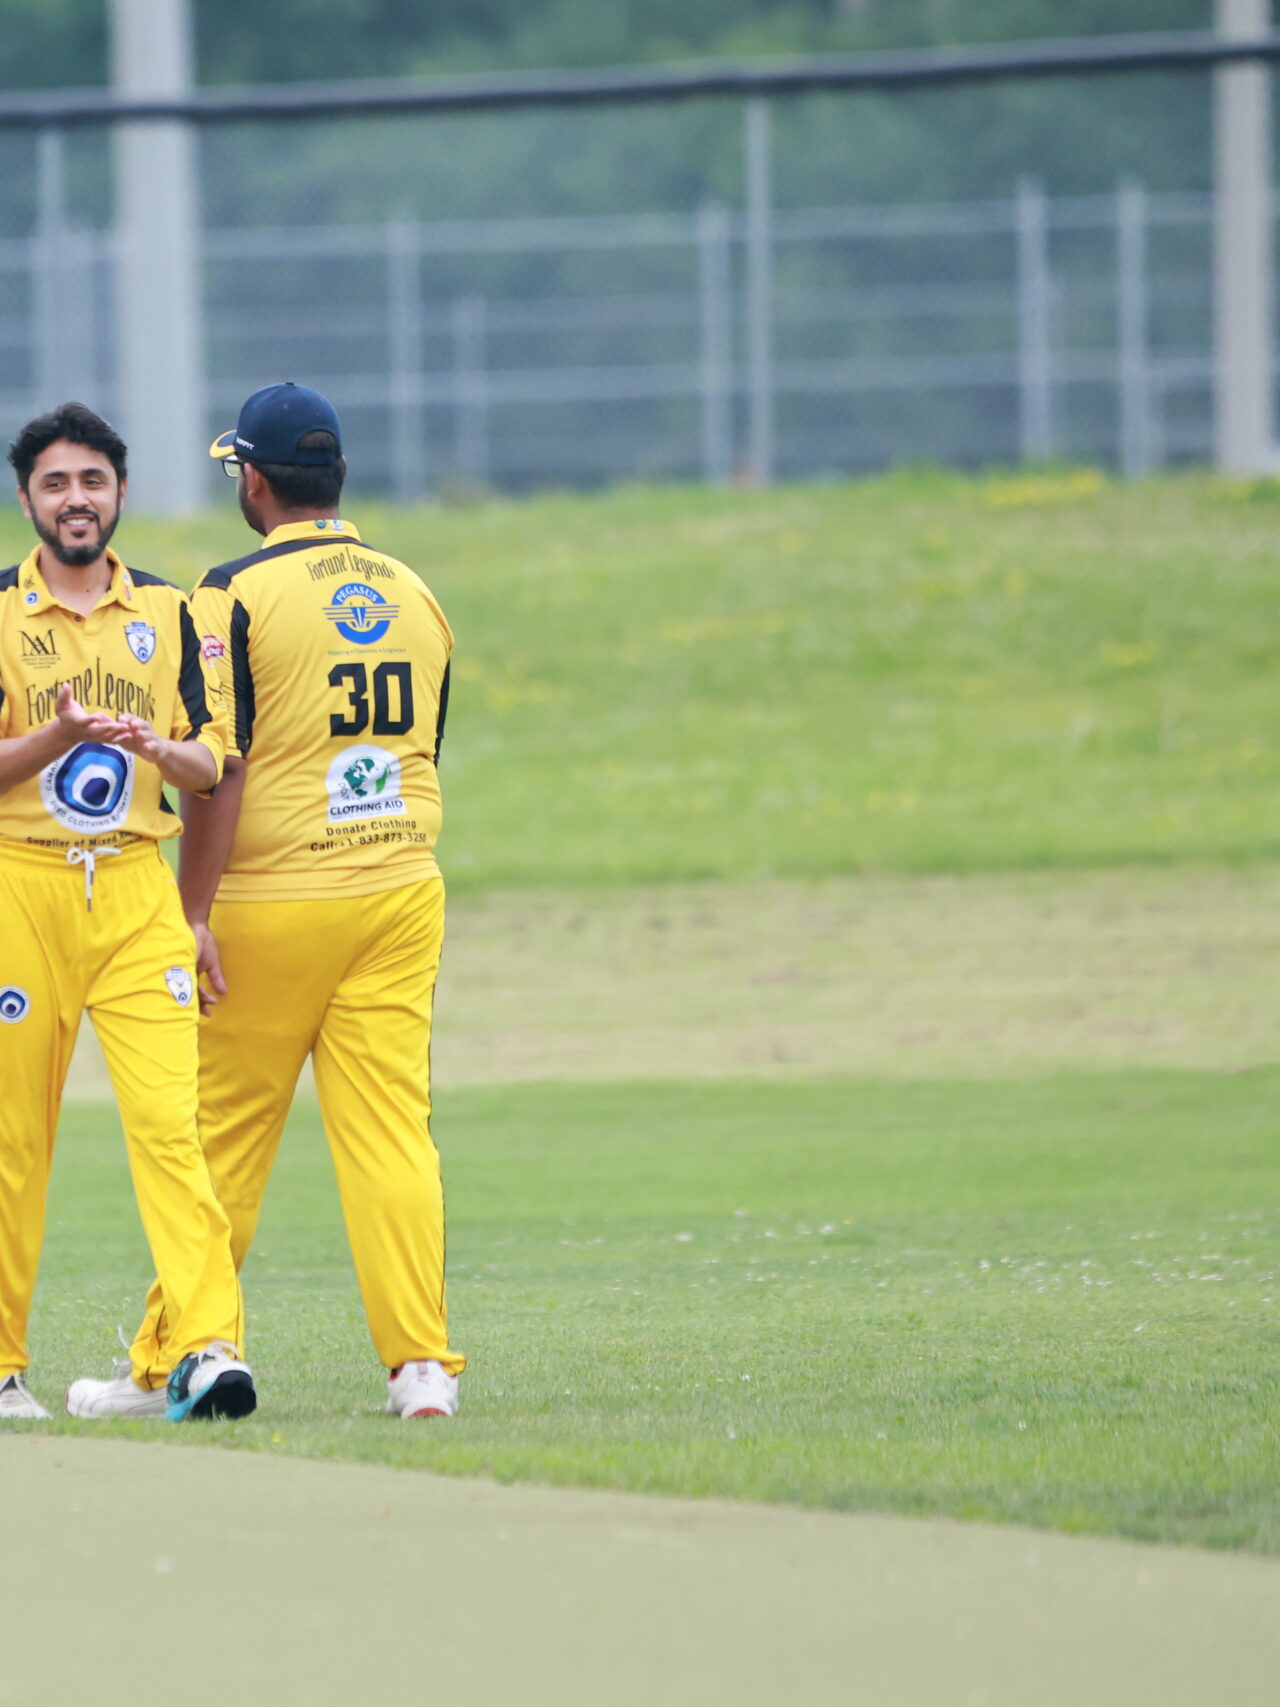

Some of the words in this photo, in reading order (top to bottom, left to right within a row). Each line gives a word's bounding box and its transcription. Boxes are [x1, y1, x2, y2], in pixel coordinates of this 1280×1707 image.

[305, 552, 347, 581] Fortune
[345, 547, 395, 581] Legends
[336, 586, 379, 603] PEGASUS
[328, 662, 414, 737] 30
[330, 802, 382, 816] CLOTHING
[385, 800, 403, 810] AID
[68, 815, 110, 828] CLOTHING
[326, 823, 367, 836] Donate
[370, 818, 417, 831] Clothing
[26, 836, 70, 847] Supplier
[74, 838, 85, 848] of
[89, 835, 118, 847] Mixed
